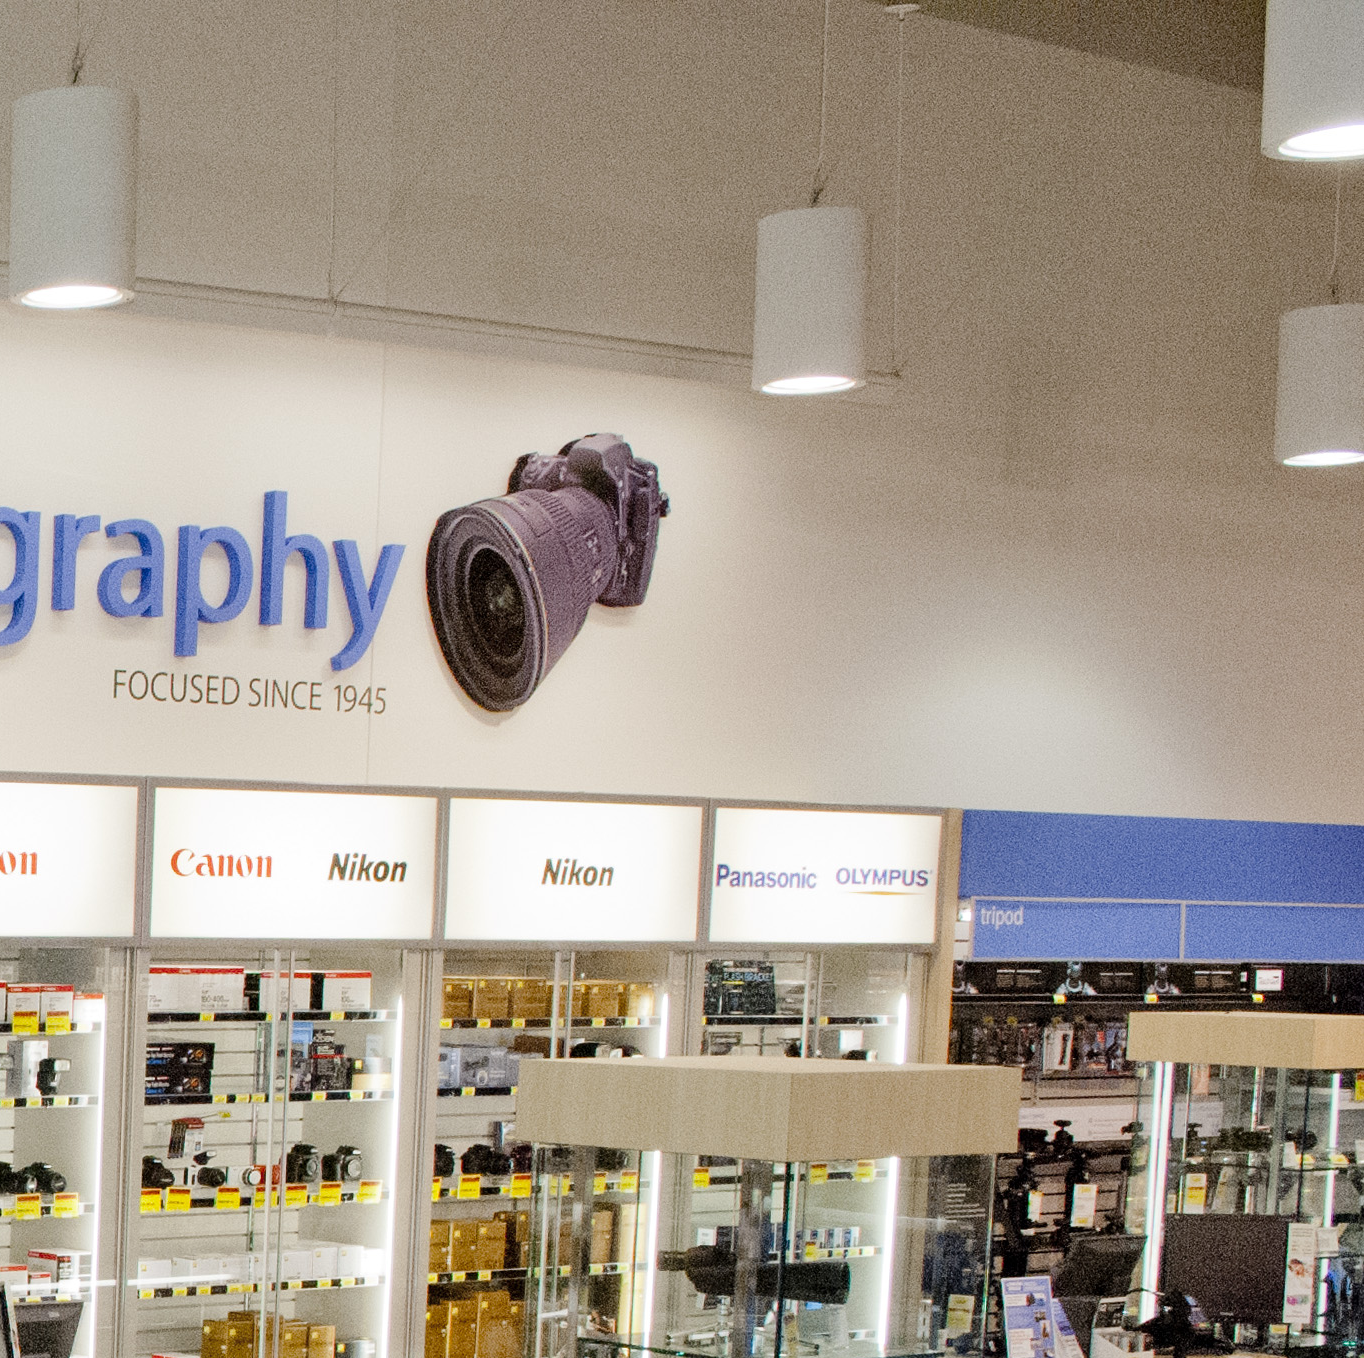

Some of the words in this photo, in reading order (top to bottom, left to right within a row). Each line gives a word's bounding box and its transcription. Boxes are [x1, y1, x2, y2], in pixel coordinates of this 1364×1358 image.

[114, 670, 241, 708] FOCUSED
[248, 677, 324, 713] SINCE
[333, 682, 388, 717] 1945
[169, 847, 273, 878] Canon
[327, 852, 407, 884] Nikon
[540, 857, 614, 888] Nikon
[715, 864, 817, 891] Panasonic
[835, 865, 930, 888] OLYMPUS
[980, 905, 1024, 930] tripod
